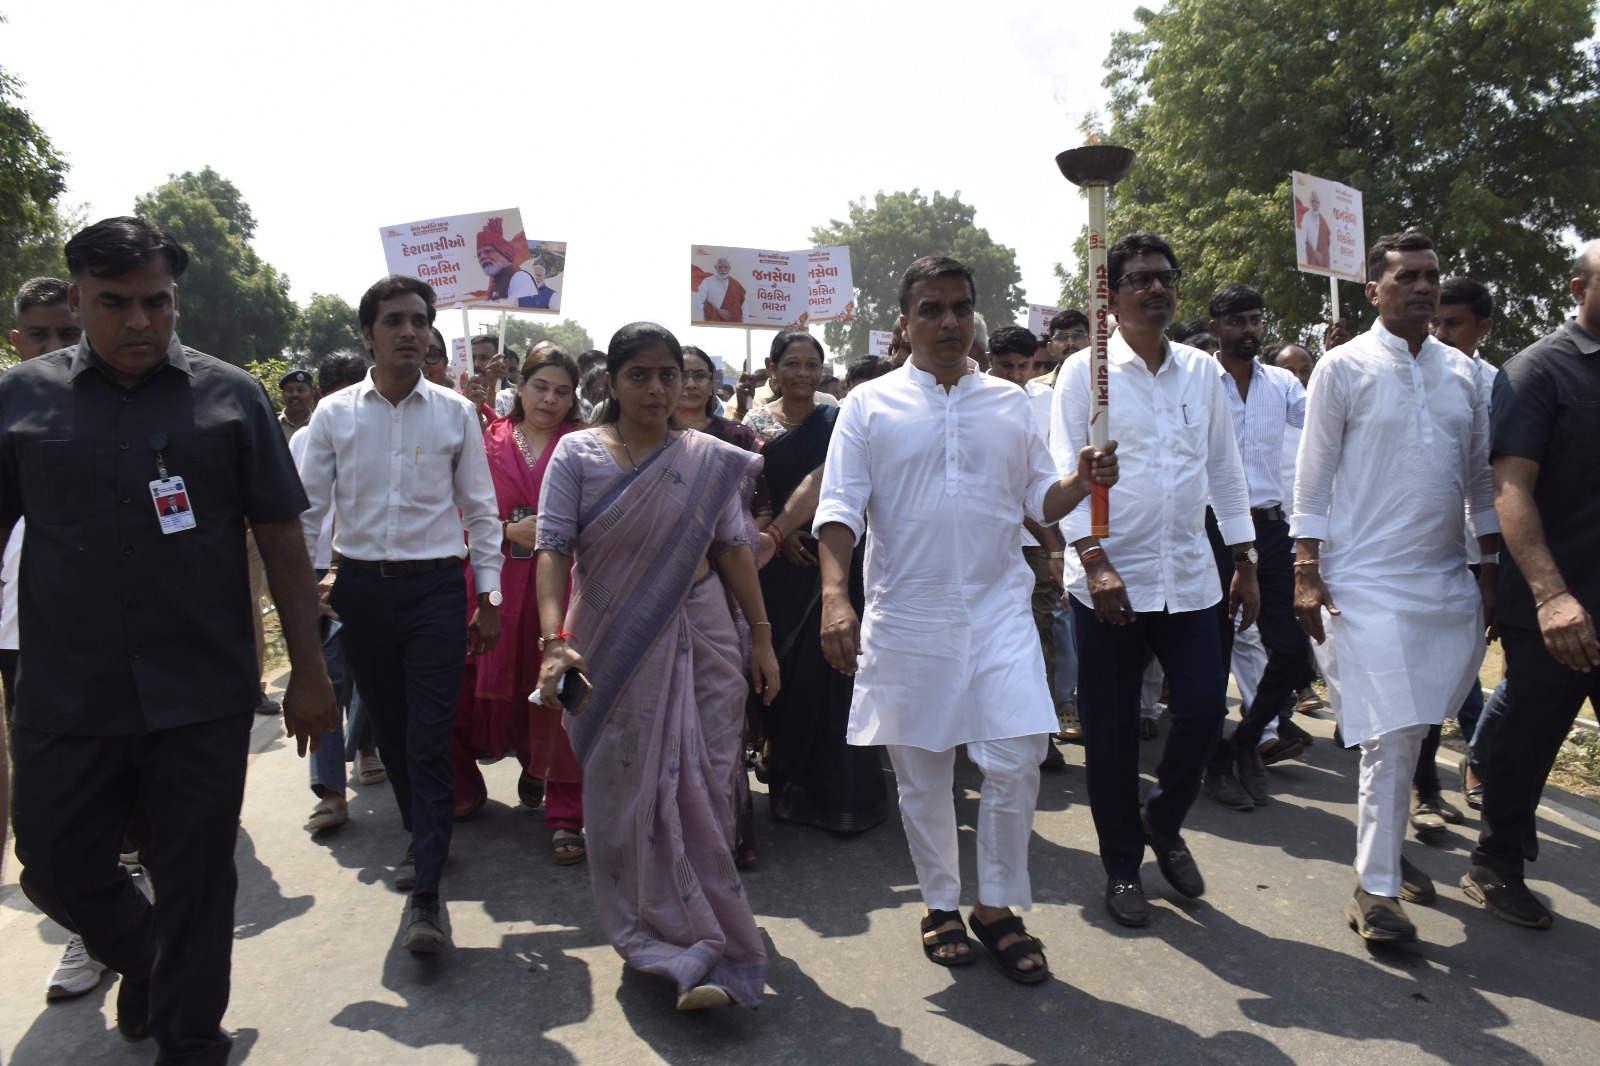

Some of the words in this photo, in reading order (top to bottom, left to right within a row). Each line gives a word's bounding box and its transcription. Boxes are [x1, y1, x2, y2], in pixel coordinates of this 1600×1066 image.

[402, 235, 465, 256] દેશવાસીઓ
[417, 260, 461, 277] વિકસિત
[752, 266, 795, 283] જનસેવા
[808, 264, 838, 278] નસેવા
[427, 275, 457, 286] ભારત
[757, 288, 791, 301] વિકસિત
[762, 302, 786, 311] ભારત
